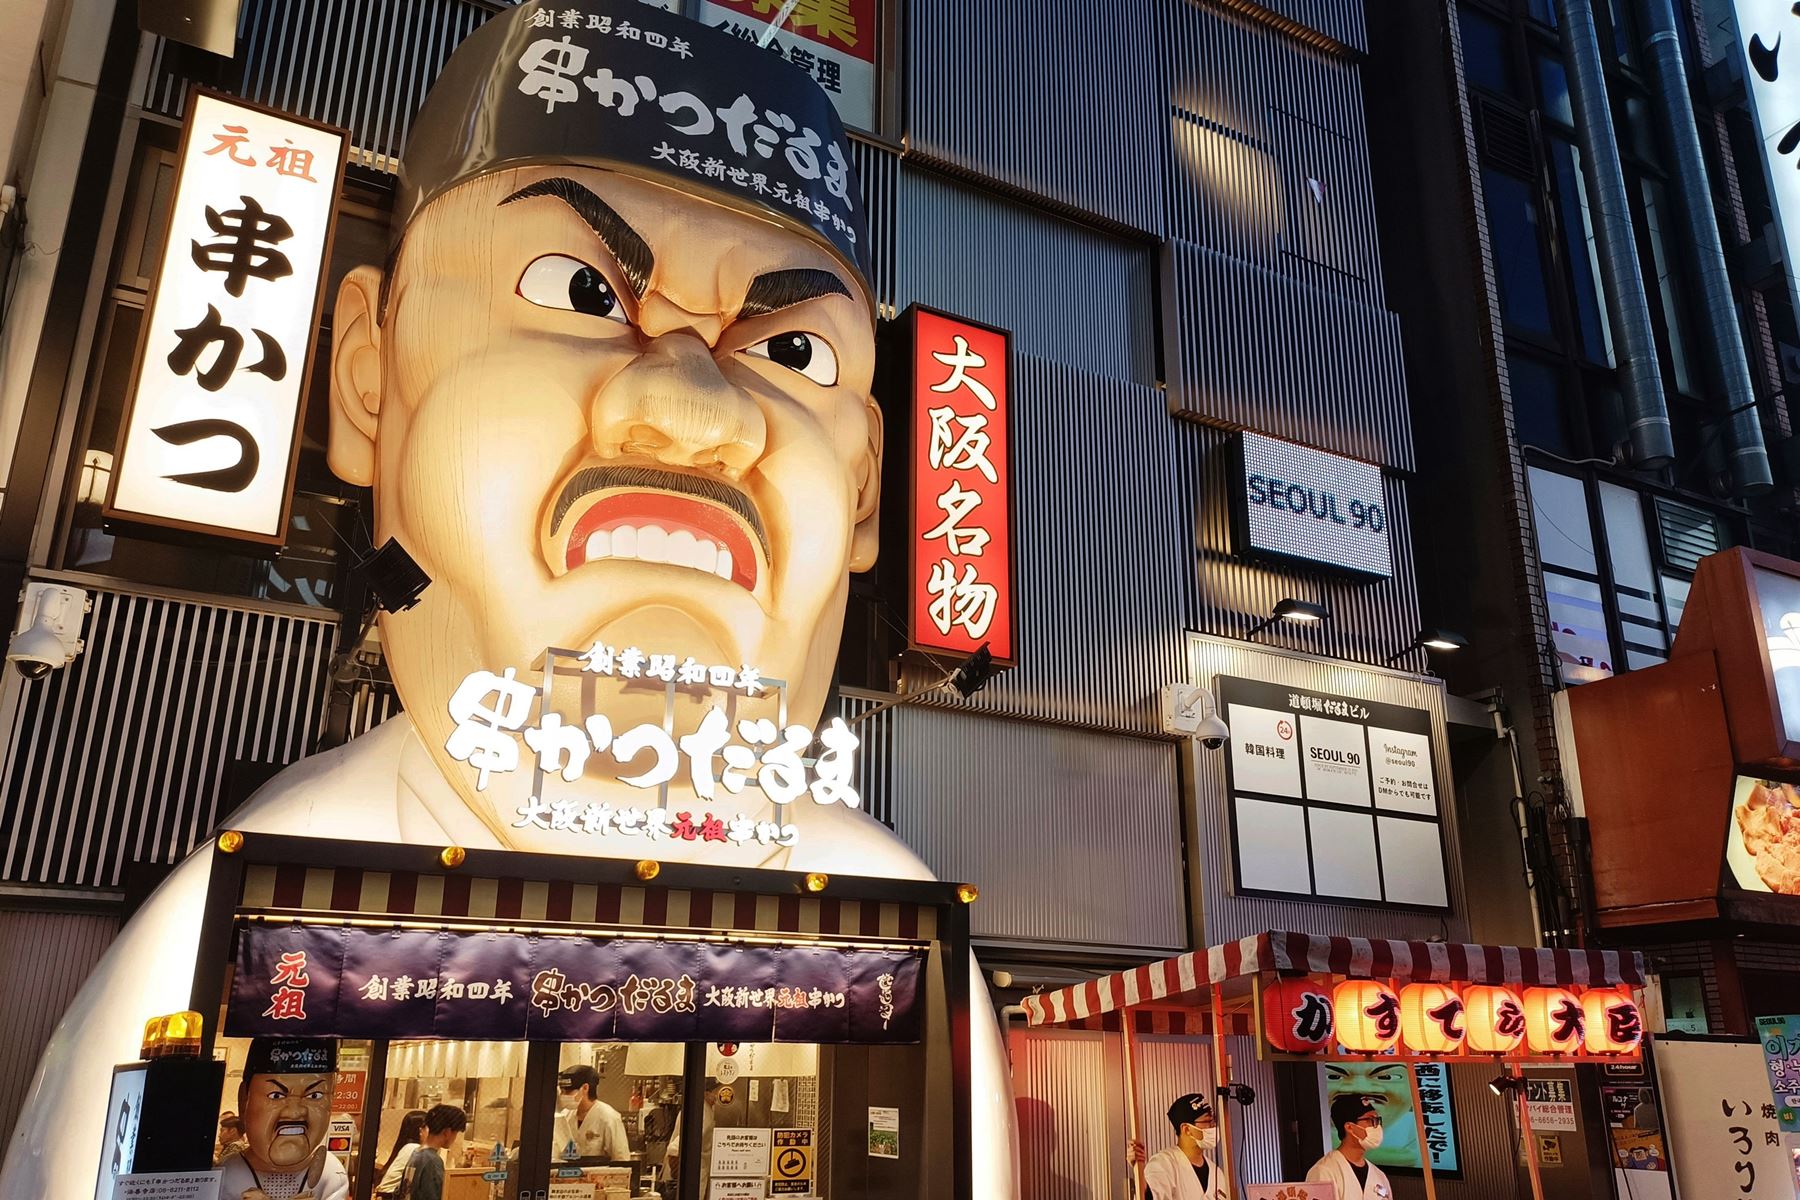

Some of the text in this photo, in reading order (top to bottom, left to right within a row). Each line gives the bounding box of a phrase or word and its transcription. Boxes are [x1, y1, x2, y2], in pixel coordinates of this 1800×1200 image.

[524, 8, 695, 60] 創業昭和四年
[517, 35, 855, 212] 串かつだるま
[202, 124, 319, 184] 元祖
[650, 141, 858, 244] 大阪新世界元祖串かつ
[150, 195, 295, 494] 串かつ
[921, 334, 1000, 640] 大阪名物
[1250, 473, 1385, 533] SEOUL 90
[577, 640, 766, 697] 創業昭和四年
[445, 666, 862, 810] 串かつだるま
[1244, 742, 1286, 759] 韓国料理
[1310, 746, 1361, 766] SEOUL 90
[1383, 743, 1418, 759] Instagram
[510, 795, 801, 848] 大阪新世界元祖串かつ
[262, 951, 311, 1020] 元祖
[358, 974, 514, 1004] 創業昭和四年
[531, 968, 700, 1018] 串かつだるま
[703, 984, 846, 1010] 大阪新世界元祖串かつ
[1760, 1103, 1780, 1147] 焼肉
